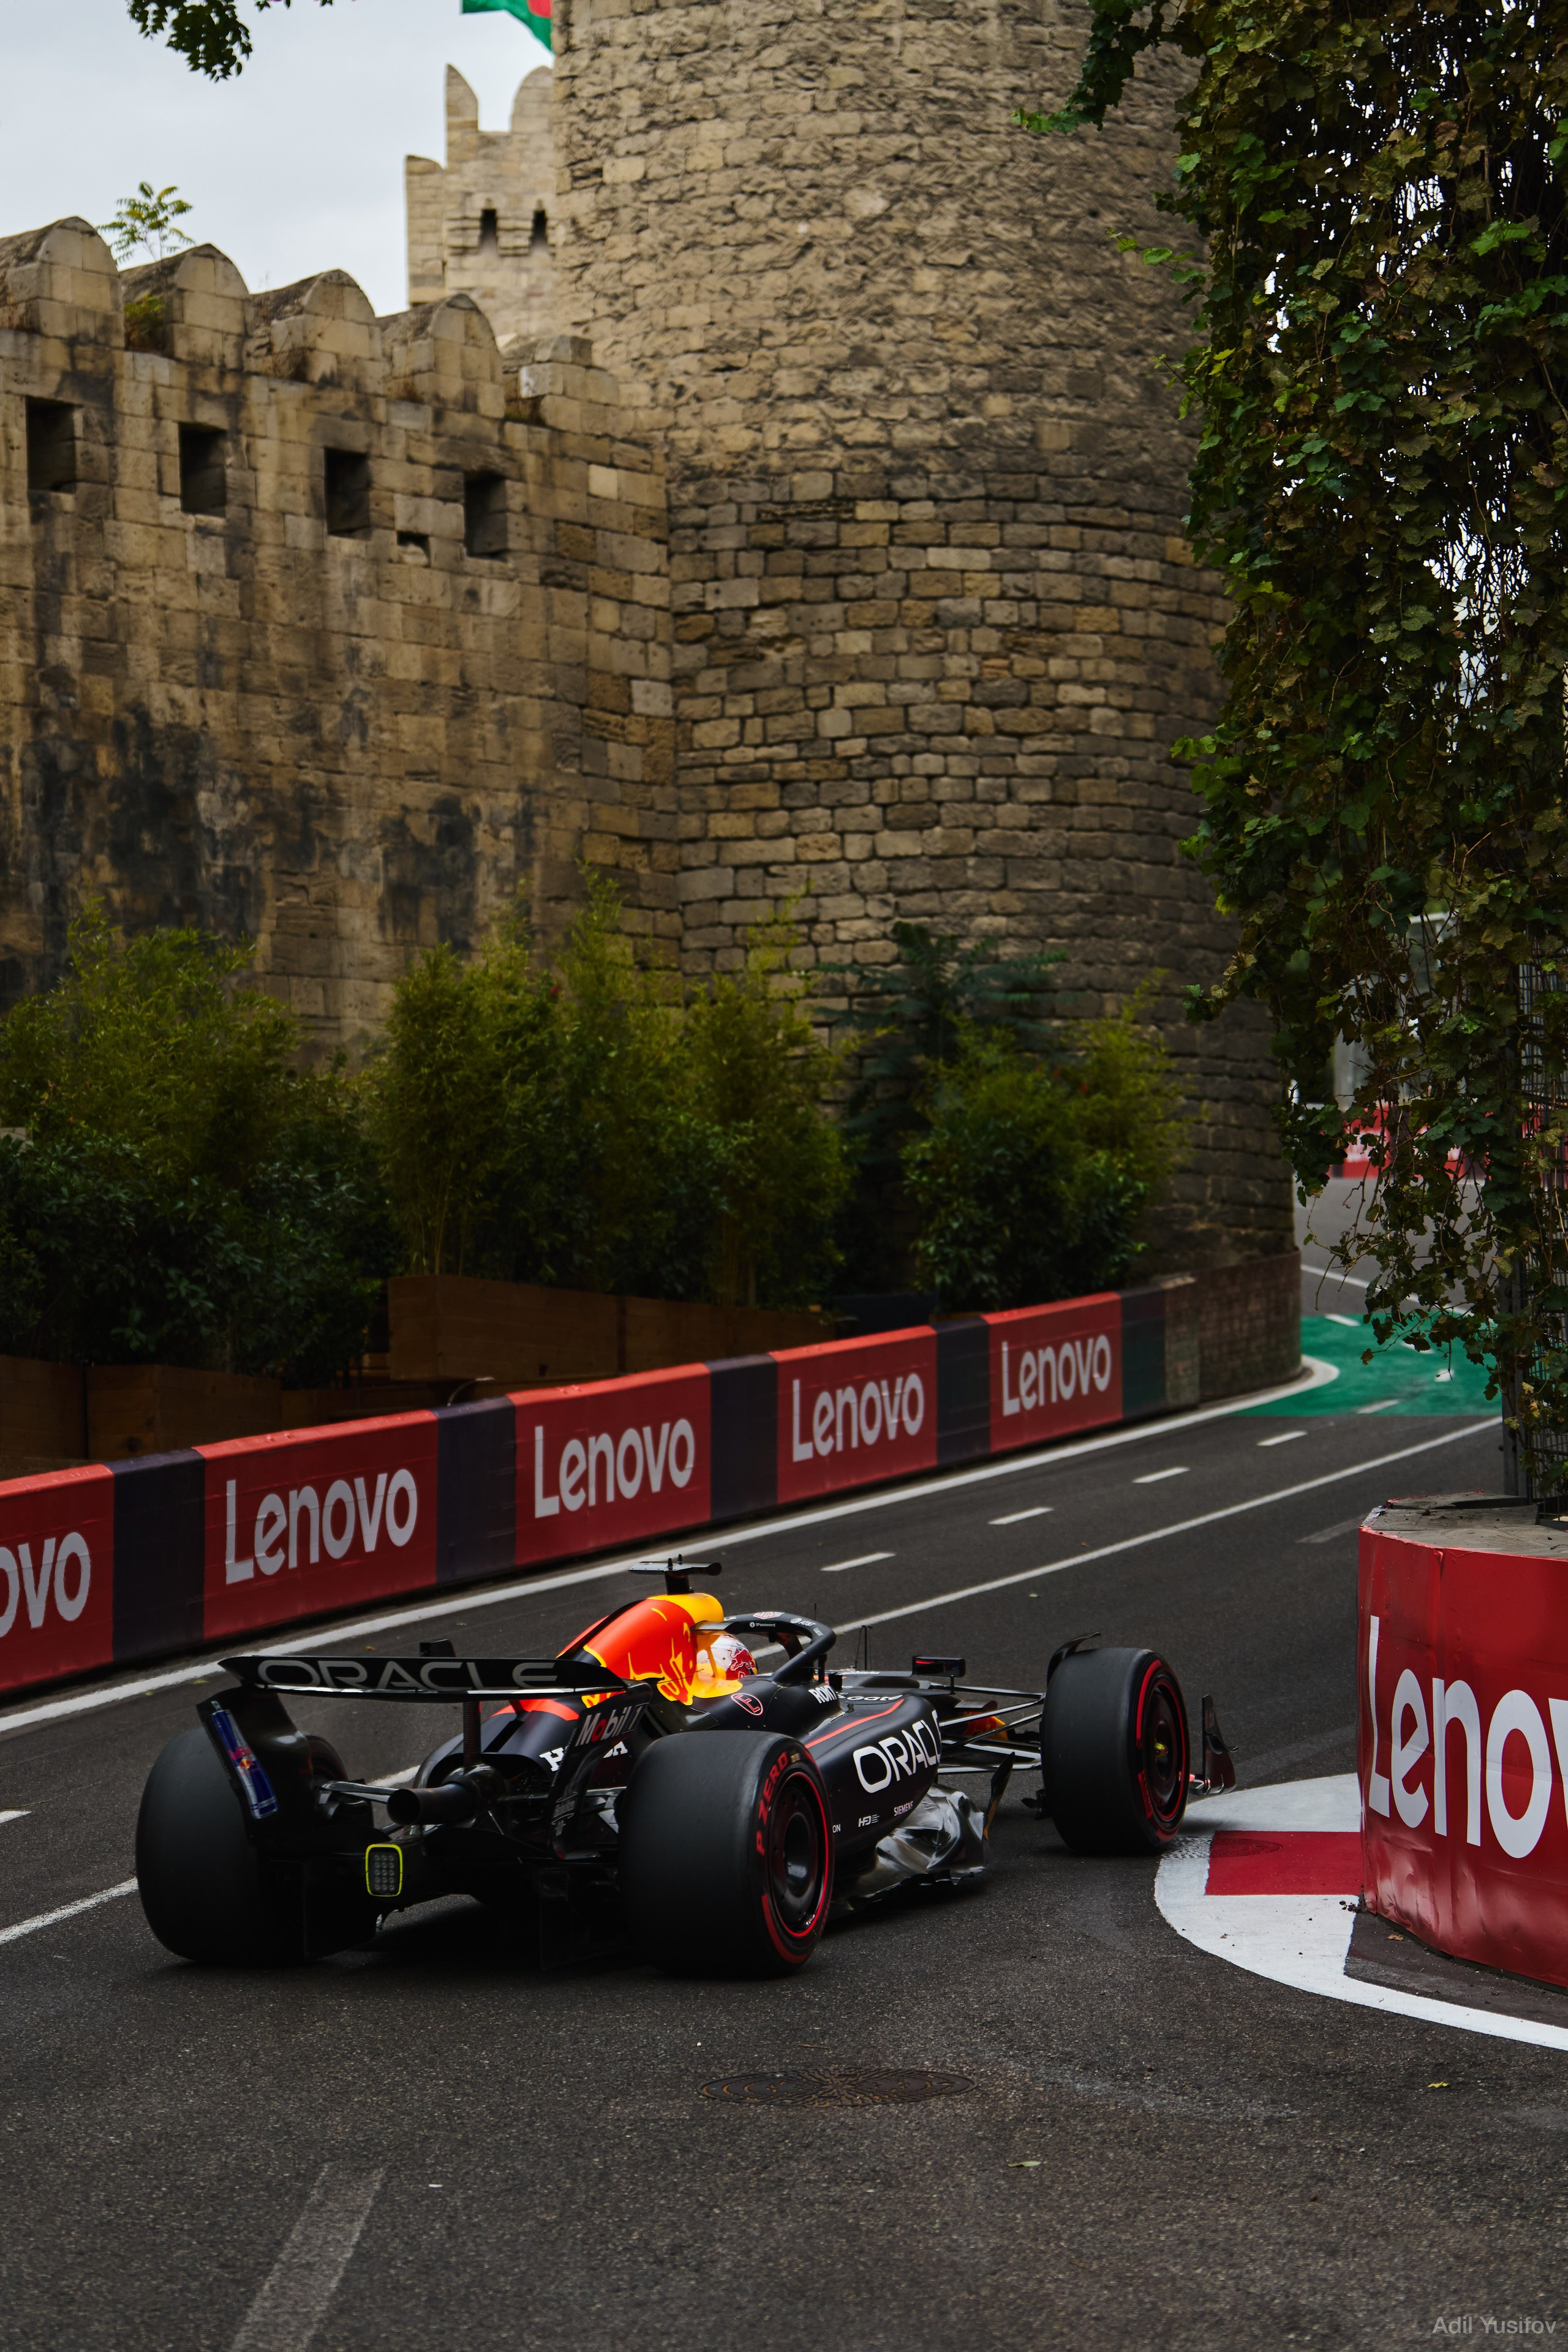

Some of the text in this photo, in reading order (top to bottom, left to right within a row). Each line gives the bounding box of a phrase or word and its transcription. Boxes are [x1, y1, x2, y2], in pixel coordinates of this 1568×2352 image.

[1002, 1335, 1112, 1415] Lenovo
[793, 1373, 924, 1461] Lenovo
[535, 1419, 695, 1518] Lenovo
[225, 1469, 417, 1584] Lenovo
[257, 1660, 558, 1690] ORACLE
[575, 1706, 633, 1747] Mobil
[759, 1751, 788, 1826] ZERO
